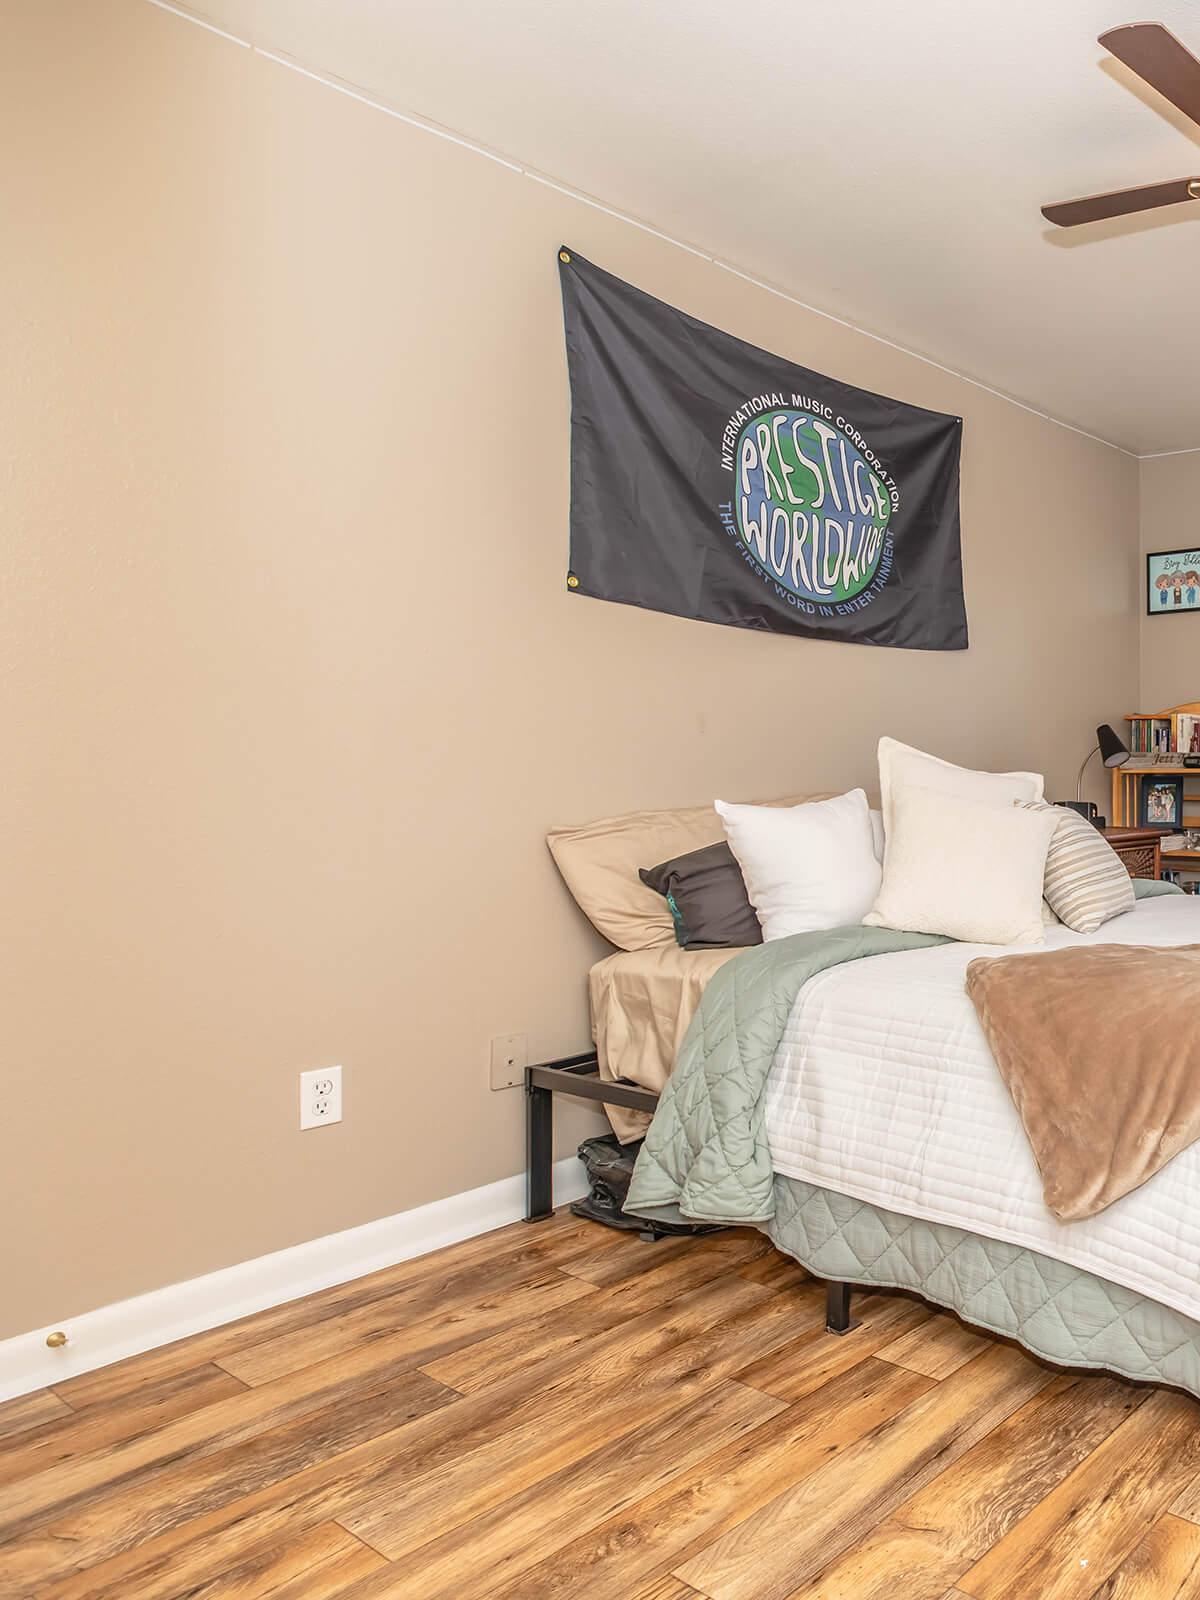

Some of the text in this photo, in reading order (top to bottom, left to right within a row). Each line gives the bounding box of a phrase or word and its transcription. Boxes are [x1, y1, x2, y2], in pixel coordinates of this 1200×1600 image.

[720, 392, 900, 513] INTERNATIONAL MUSIC CORPORATION
[741, 415, 888, 520] PRESTIGE
[718, 501, 737, 537] THE
[735, 540, 772, 584] FIRST
[774, 585, 815, 614] WORD
[818, 605, 834, 617] IN
[741, 495, 885, 595] WORLDWIDE
[1152, 753, 1174, 765] Jett
